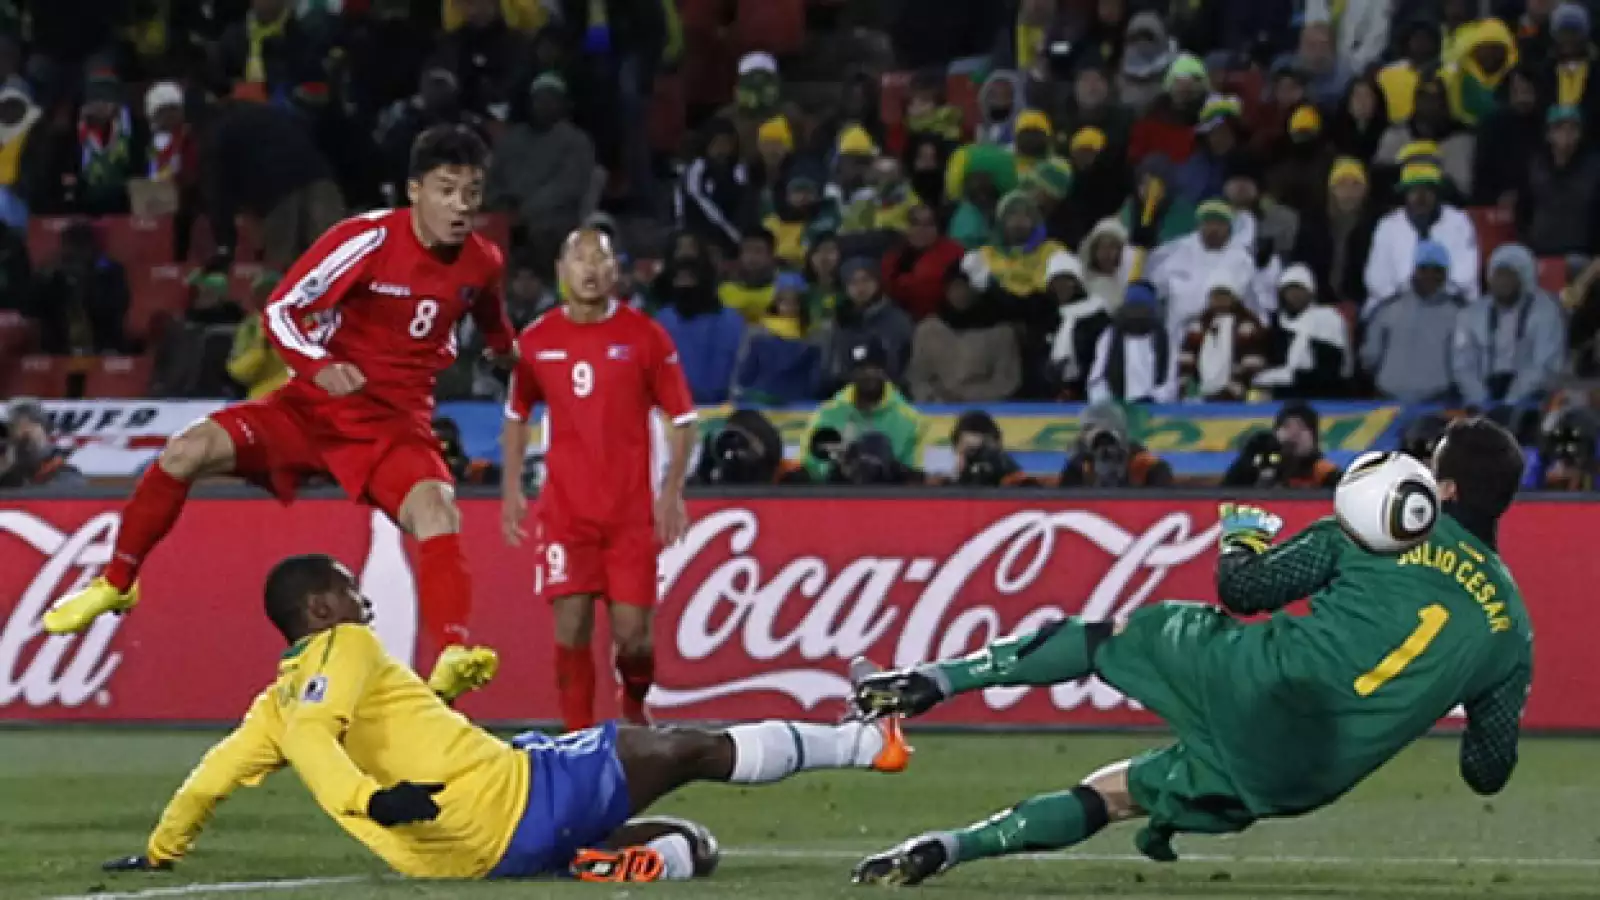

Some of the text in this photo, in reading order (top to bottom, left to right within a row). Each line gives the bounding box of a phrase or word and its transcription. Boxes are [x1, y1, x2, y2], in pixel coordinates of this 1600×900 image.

[409, 299, 438, 338] 8
[572, 360, 594, 398] 9
[546, 542, 566, 577] 9
[646, 508, 1222, 711] Coca-Col
[1456, 560, 1511, 634] CESAR
[1354, 603, 1449, 697] 1
